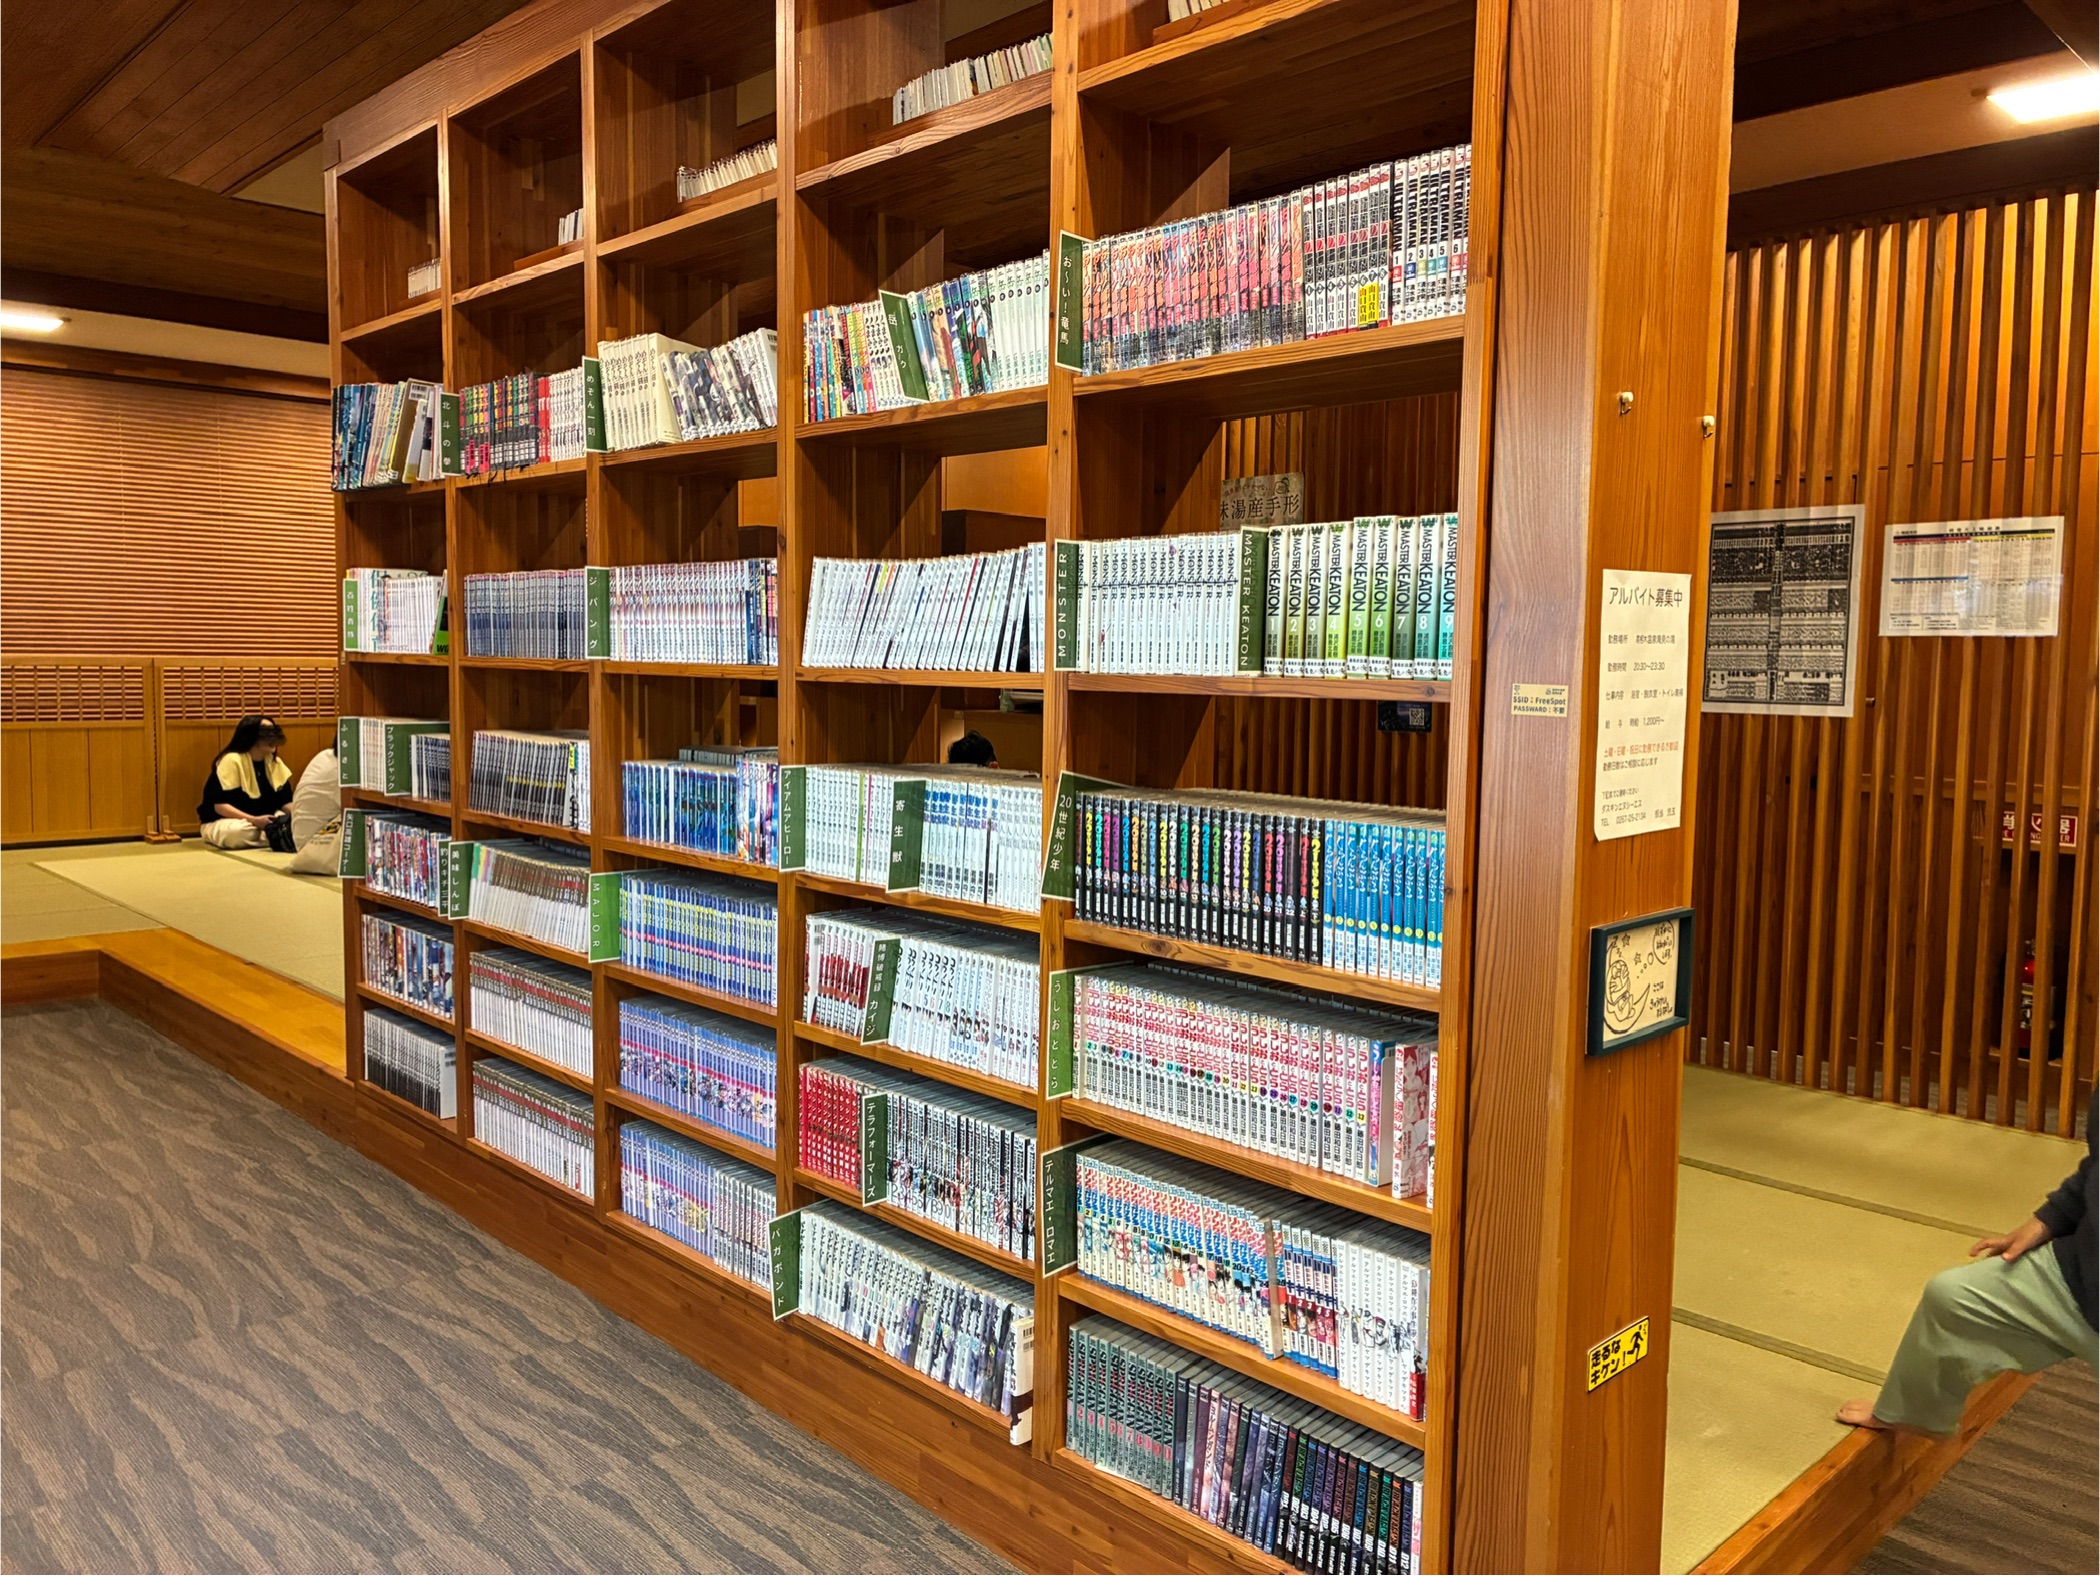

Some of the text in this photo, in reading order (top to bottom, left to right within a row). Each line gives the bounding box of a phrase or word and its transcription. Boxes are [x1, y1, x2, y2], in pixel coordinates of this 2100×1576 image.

[1395, 256, 1398, 265] 1
[1408, 252, 1413, 261] 2
[1419, 249, 1424, 258] 3
[1429, 248, 1434, 258] 4
[1440, 245, 1445, 255] 5
[1453, 244, 1458, 253] 6
[442, 400, 450, 466] 北斗の拳
[587, 375, 595, 436] めぞん一刻
[1058, 552, 1068, 657] MONSTER
[1240, 533, 1253, 666] MASTER KEATON
[1268, 538, 1280, 631] MASTER KEATON 1
[1289, 538, 1302, 632] MASTER KEATON 2
[1308, 536, 1321, 632] MASTER KEATON 3
[1328, 535, 1342, 630] MASTER KEATON 4
[1352, 529, 1368, 627] MASTER KEATON 5
[1374, 529, 1389, 628] MASTER KEATON 6
[1396, 530, 1411, 629] MASTER KEATON 7
[1418, 529, 1433, 629] MASTER KEATON 8
[1443, 560, 1457, 613] KEATON
[1609, 587, 1683, 607] アルバイト募集中
[589, 577, 598, 648] ジパング
[1445, 614, 1453, 628] 9
[1608, 635, 1628, 644] 勤務場所
[1606, 690, 1624, 700] 仕事内容
[1608, 662, 1627, 672] 勤務時間
[1536, 697, 1566, 705] FreeSpot
[387, 726, 395, 790] ブラックジャック
[784, 770, 792, 865] アイアムアヒーロー
[892, 800, 904, 863] 寄生獣
[1050, 795, 1072, 872] 20世紀少年
[1601, 818, 1609, 826] TEL
[451, 850, 460, 912] 美味しんぼ
[592, 883, 600, 948] MAJOR
[867, 1000, 878, 1036] カイジ
[1051, 981, 1061, 1089] うしおととら
[866, 1102, 876, 1198] テラフォーマーズ
[1045, 1160, 1055, 1264] テルマエ・ロマエ
[771, 1229, 785, 1307] バガボンド
[1591, 1339, 1621, 1369] 走るな
[1078, 1408, 1083, 1419] 2
[1127, 1430, 1133, 1441] 7
